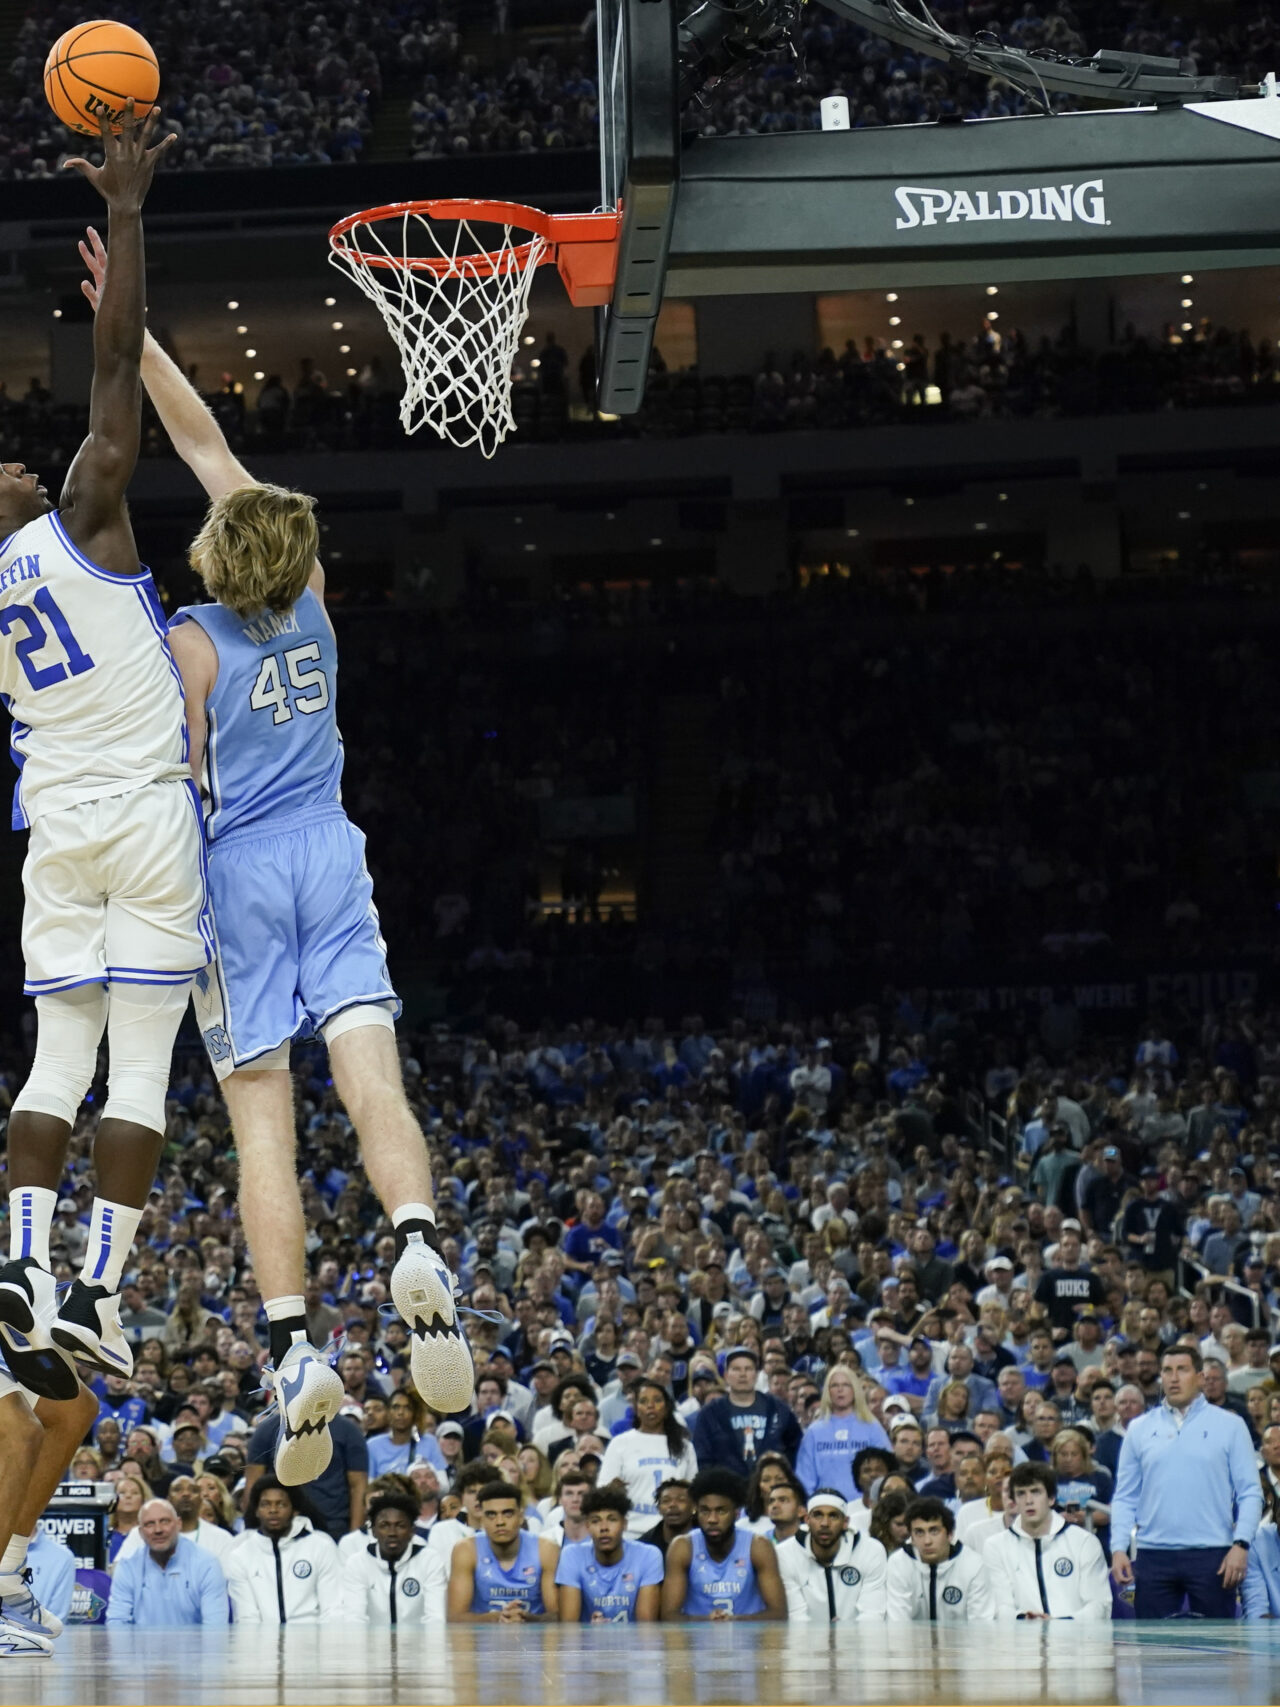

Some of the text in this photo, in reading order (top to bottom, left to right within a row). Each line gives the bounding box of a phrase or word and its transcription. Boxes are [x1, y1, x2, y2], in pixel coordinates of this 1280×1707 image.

[894, 179, 1106, 230] SPALDING
[243, 607, 301, 647] MANEK
[249, 641, 330, 726] 45
[1055, 1279, 1090, 1297] DUKE
[37, 1518, 95, 1535] POWER
[489, 1587, 529, 1598] NORTH
[703, 1580, 741, 1593] NORTH
[593, 1595, 630, 1607] NORTH
